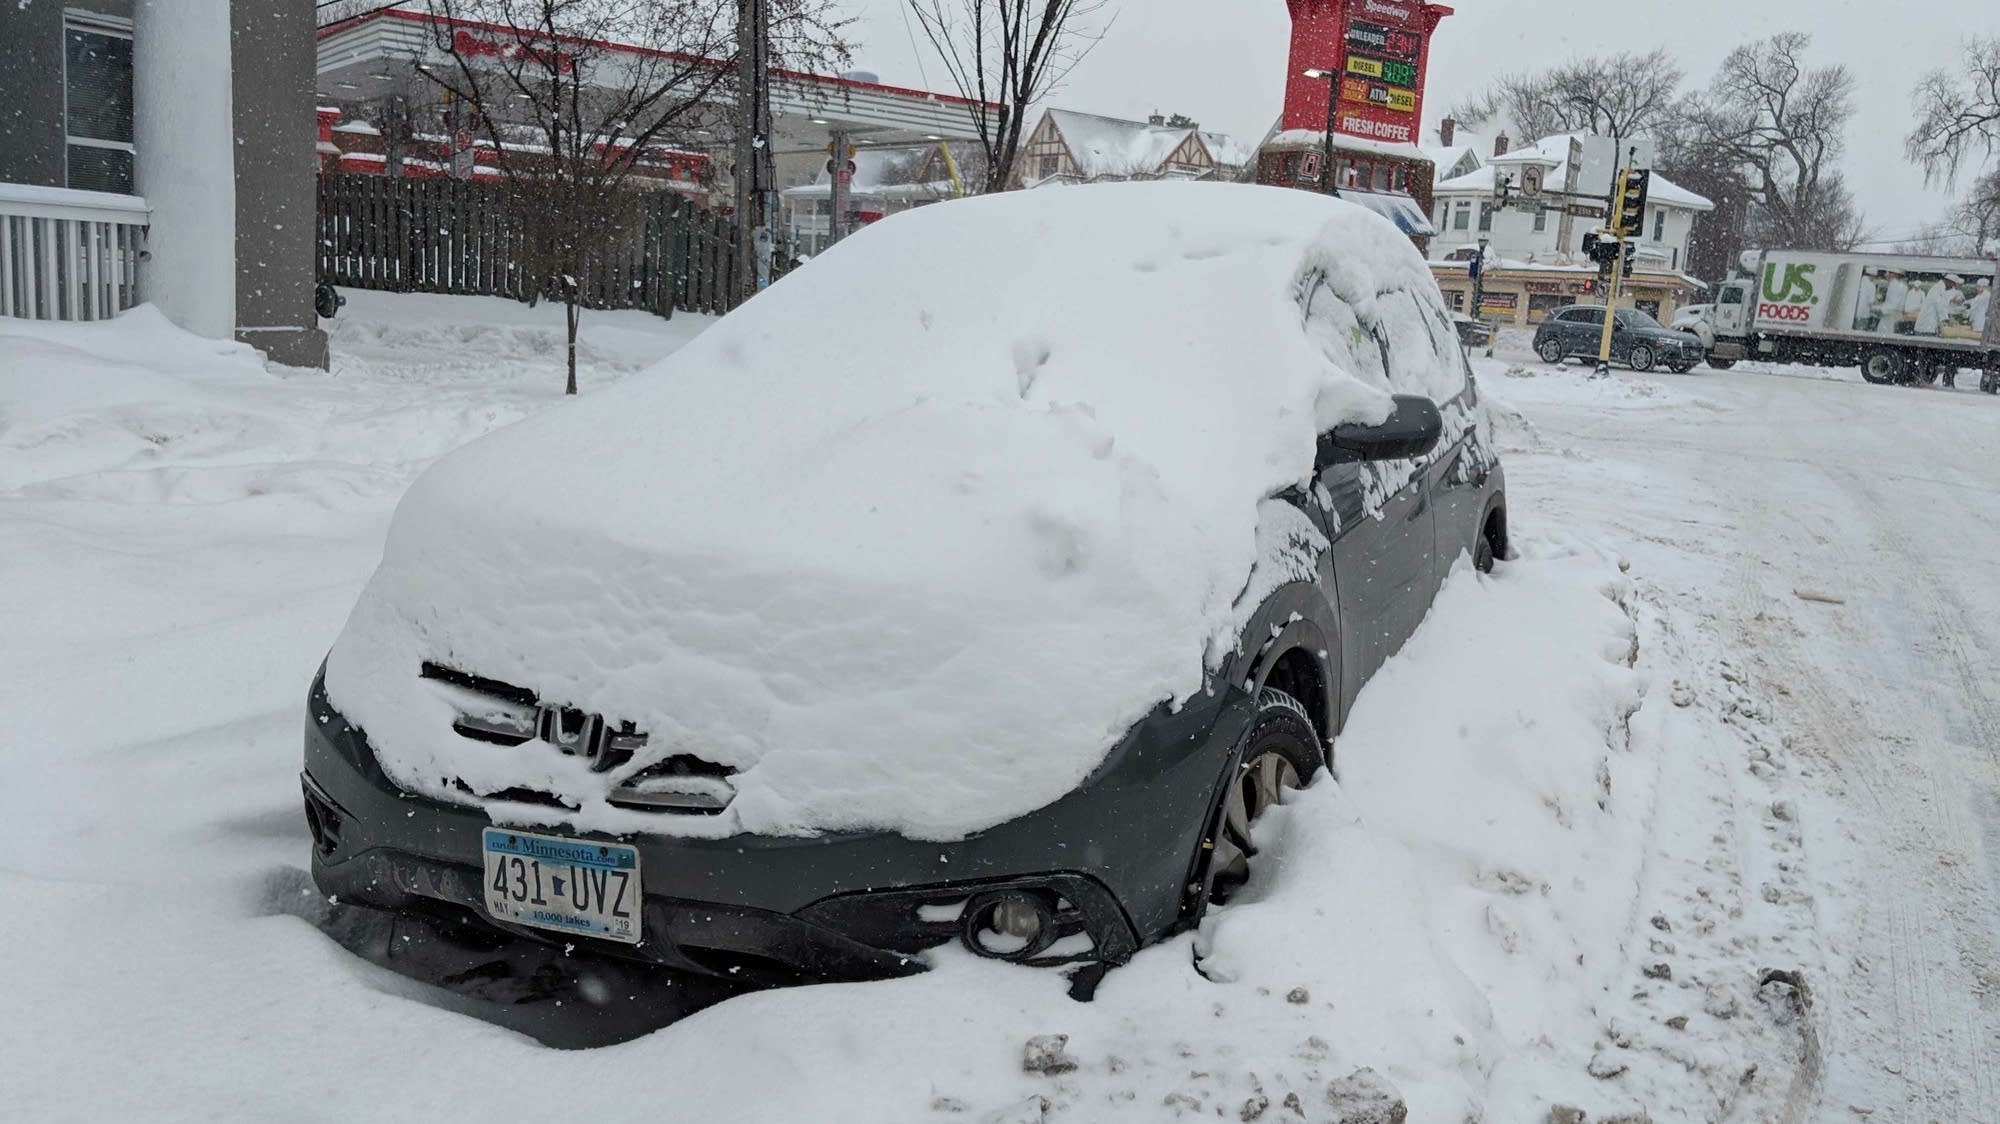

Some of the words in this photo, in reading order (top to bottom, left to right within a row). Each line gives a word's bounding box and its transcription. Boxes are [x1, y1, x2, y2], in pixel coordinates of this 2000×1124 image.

[1365, 0, 1409, 20] Speedway
[1350, 29, 1384, 44] UNLEADED
[1353, 60, 1375, 73] DIESEL
[1369, 88, 1387, 101] ATM
[1390, 94, 1413, 107] DIESEL
[1343, 117, 1374, 134] FRESH
[1375, 122, 1410, 140] COFFEE
[1758, 303, 1810, 321] FOODS
[493, 855, 547, 906] 431
[570, 865, 630, 918] UVZ
[494, 900, 509, 914] MAY
[533, 911, 563, 923] 10,000
[565, 912, 591, 927] lakes
